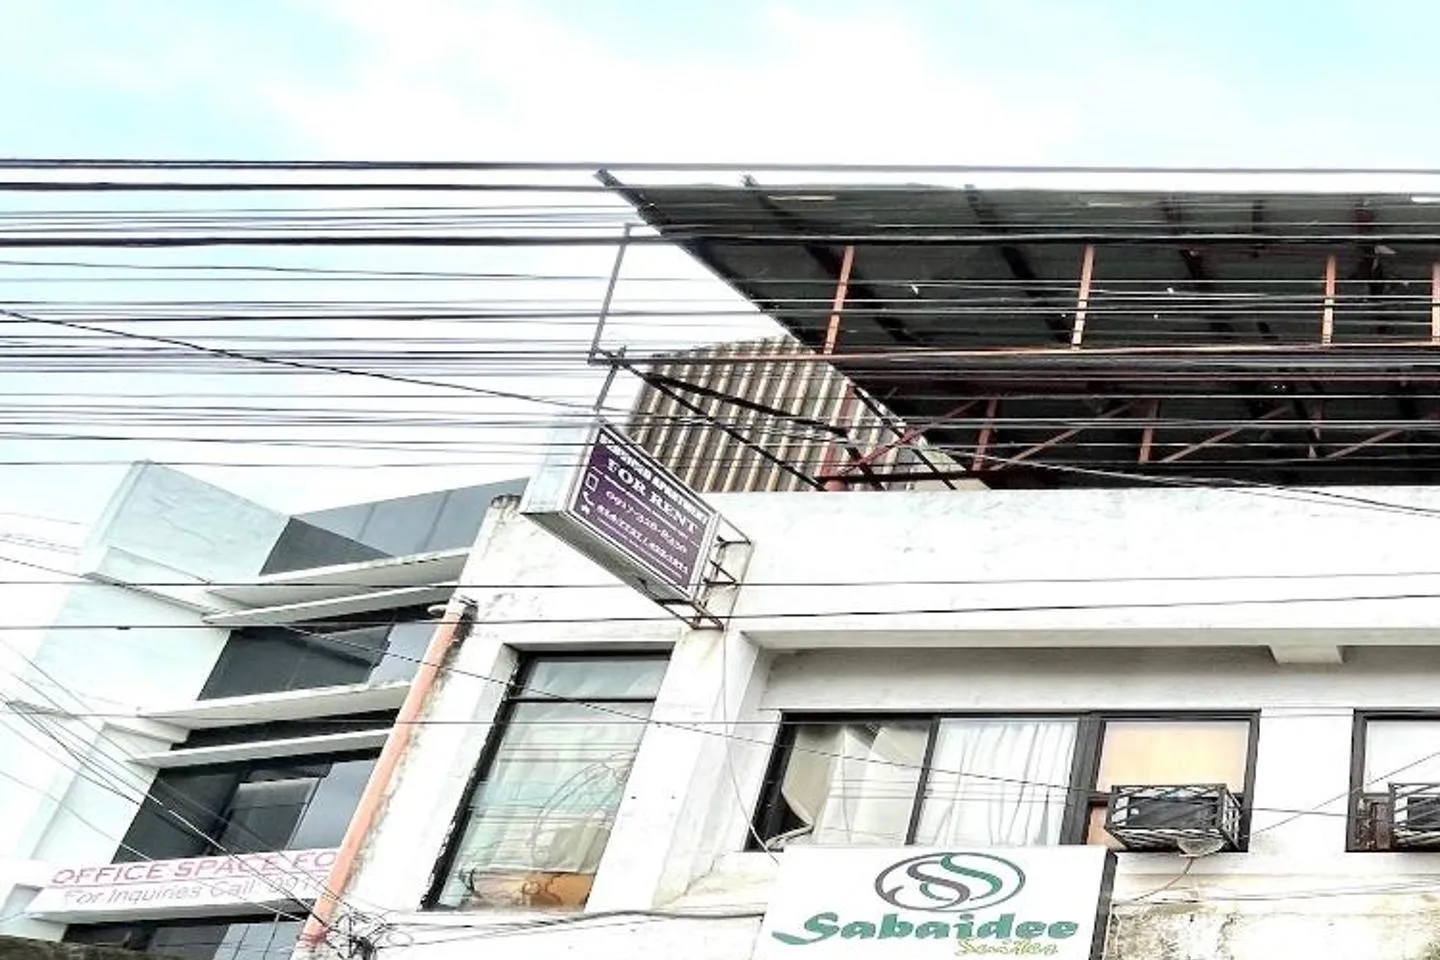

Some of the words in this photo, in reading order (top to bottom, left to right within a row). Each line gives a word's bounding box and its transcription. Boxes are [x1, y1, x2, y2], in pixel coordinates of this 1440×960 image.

[607, 457, 648, 497] FOR
[651, 493, 699, 534] RENT
[51, 863, 169, 885] OFFICE
[173, 854, 279, 877] SPACE
[292, 851, 337, 869] FO
[65, 888, 104, 904] For
[772, 911, 1079, 946] Sabaidee
